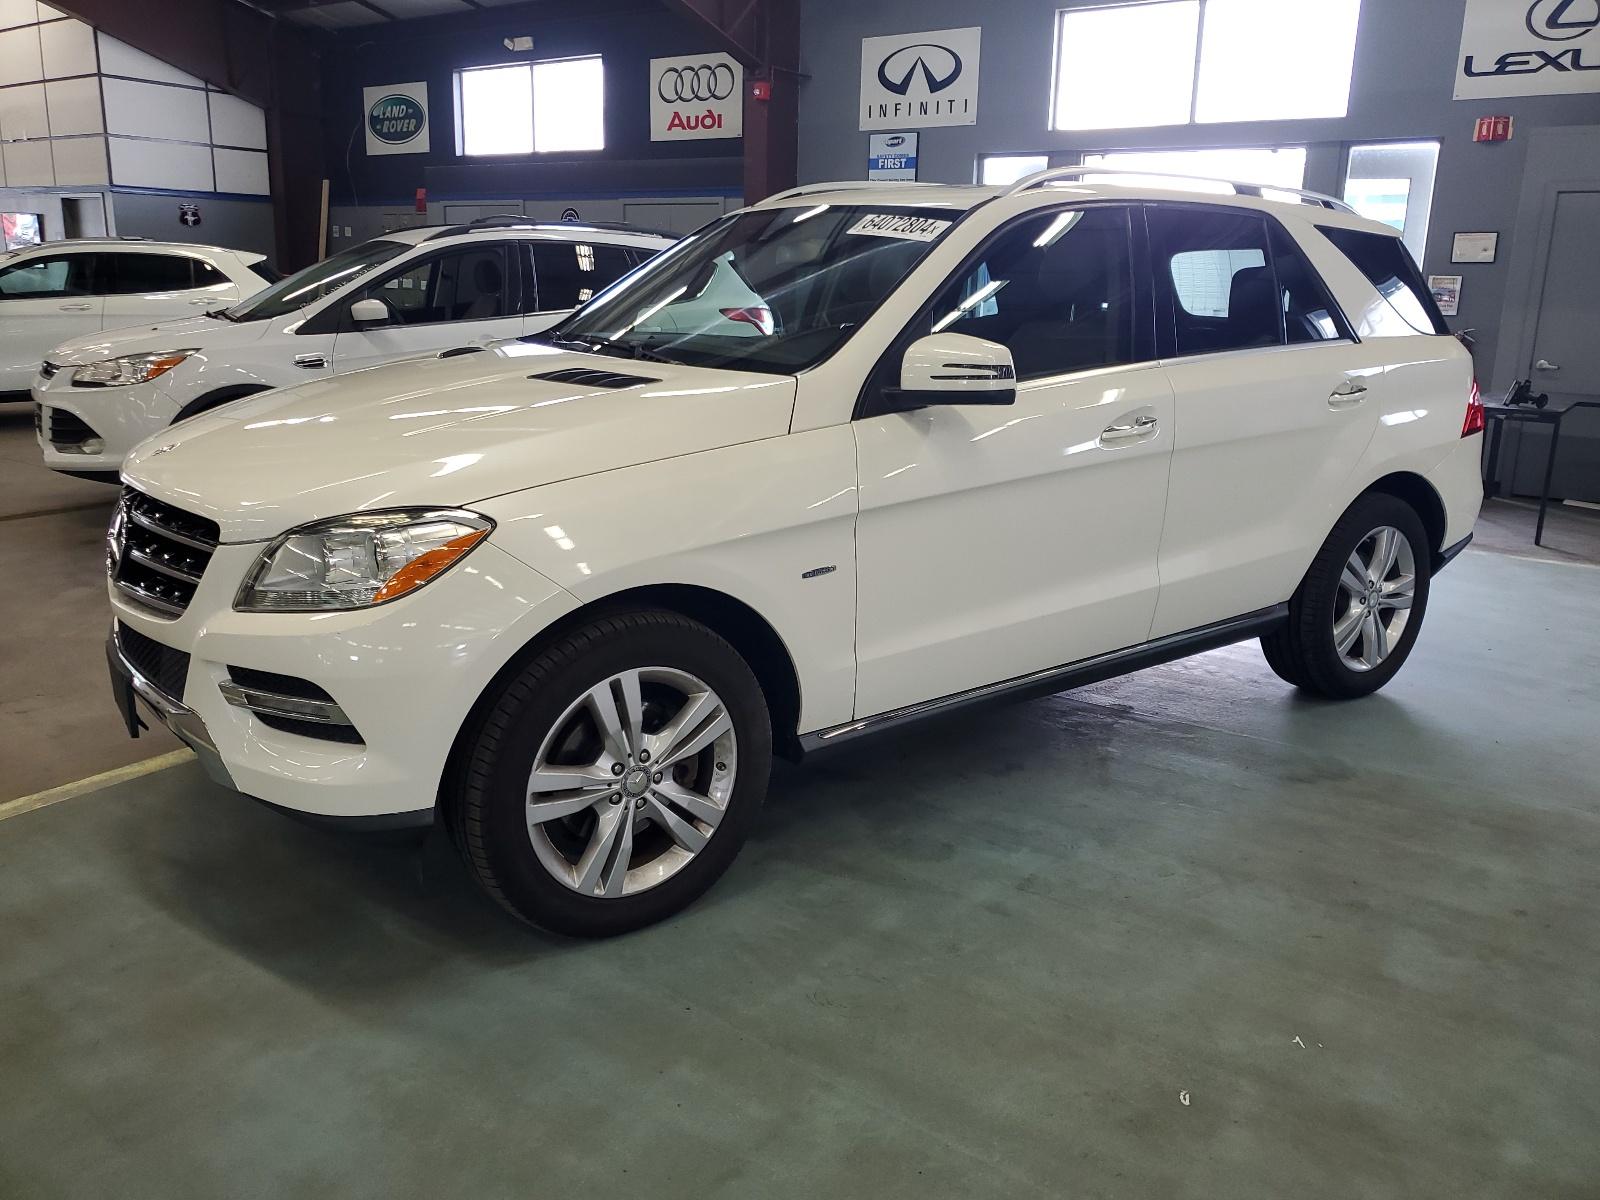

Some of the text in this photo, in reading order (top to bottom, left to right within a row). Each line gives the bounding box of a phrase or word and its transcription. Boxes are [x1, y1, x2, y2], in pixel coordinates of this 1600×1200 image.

[379, 105, 407, 119] LAND
[868, 98, 968, 119] INFINITI
[382, 119, 417, 133] ROVER
[666, 109, 723, 132] Audi
[878, 158, 907, 169] FIRST
[861, 215, 937, 235] 64072804
